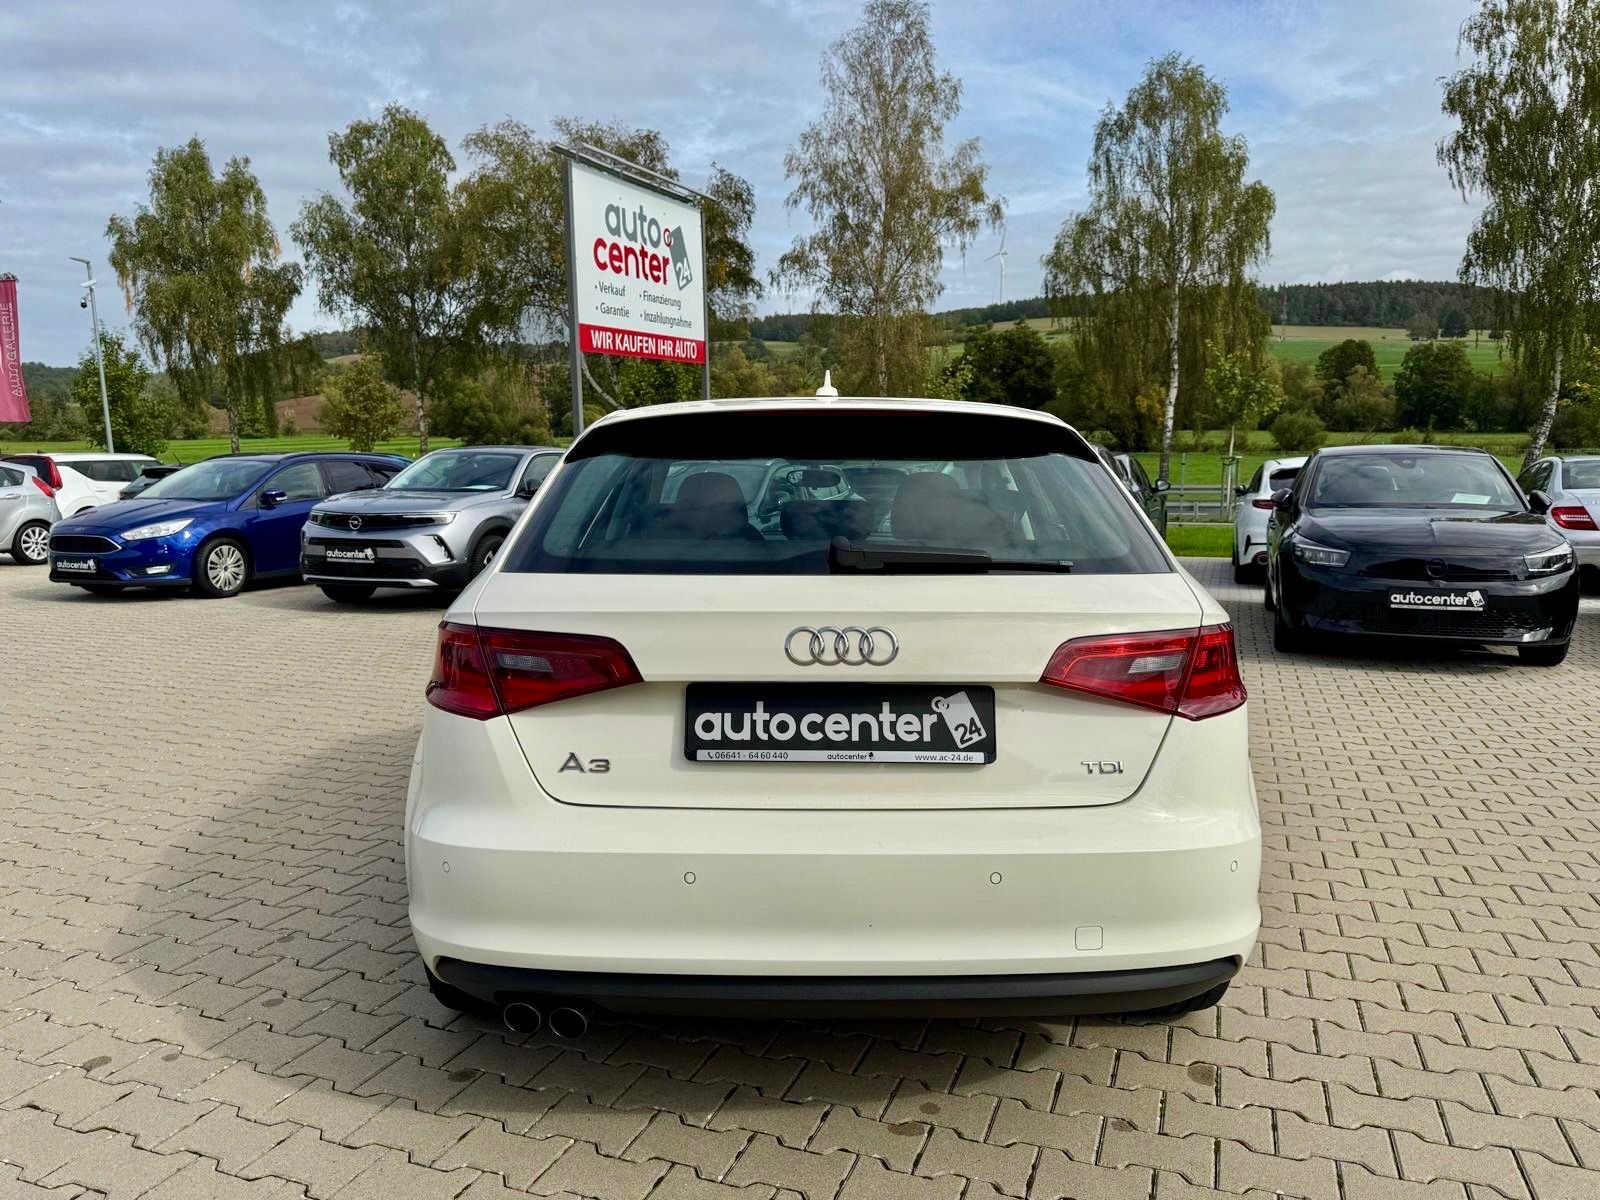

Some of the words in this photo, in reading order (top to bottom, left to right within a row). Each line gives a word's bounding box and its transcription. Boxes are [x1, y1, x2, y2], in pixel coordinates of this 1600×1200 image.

[605, 203, 661, 248] auto
[593, 237, 670, 285] center
[676, 258, 691, 287] 24
[598, 280, 626, 297] Verkauf
[600, 302, 630, 318] Garantie
[643, 290, 682, 310] Finanzierung
[643, 309, 692, 329] Inzahlungnahme
[590, 329, 613, 350] WIR
[615, 333, 656, 355] KAUFEN
[657, 338, 674, 357] IHR
[674, 340, 698, 359] AUTO
[1390, 591, 1470, 606] autocenter
[694, 700, 938, 742] autocenter
[954, 716, 983, 745] 24
[558, 752, 611, 774] A3
[714, 751, 741, 760] 06641
[826, 752, 868, 760] autocenter
[914, 754, 974, 762] www.ac-24.de
[1080, 760, 1123, 775] TDI
